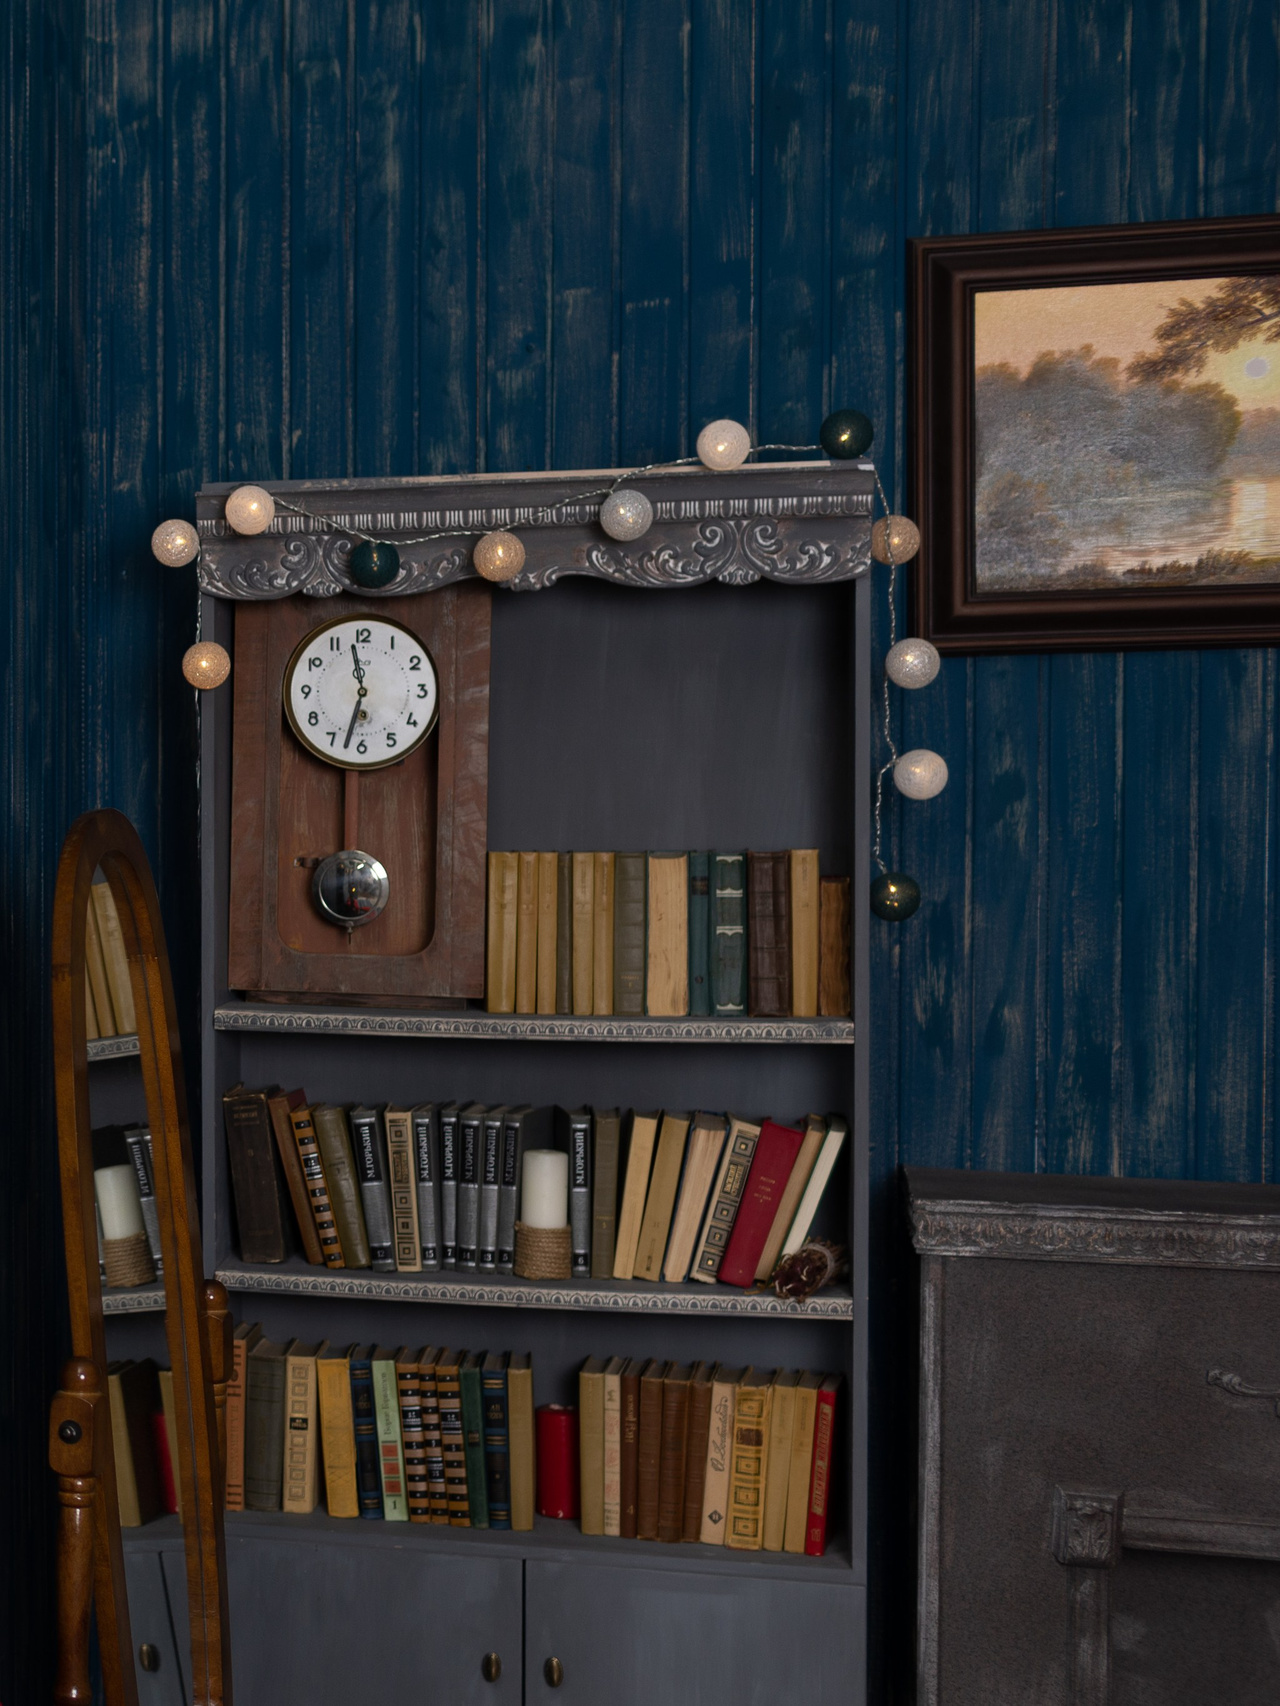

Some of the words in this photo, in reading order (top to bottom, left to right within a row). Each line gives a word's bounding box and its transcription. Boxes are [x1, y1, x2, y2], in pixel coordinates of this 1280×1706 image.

[355, 628, 371, 643] 12
[390, 635, 395, 650] 1
[329, 636, 341, 651] 11
[308, 656, 323, 672] 10
[409, 655, 422, 671] 2
[300, 684, 312, 699] 9
[417, 683, 428, 699] 3
[308, 711, 319, 726] 8
[406, 712, 418, 728] 4
[326, 731, 337, 747] 7
[356, 739, 368, 754] 6
[386, 732, 397, 748] 5
[360, 1125, 376, 1178] М.ГОРЬКИЙ
[417, 1125, 431, 1179] М.ГОРЬКИЙ
[443, 1125, 454, 1178] М.ГОРЬКИЙ
[486, 1128, 498, 1182] М.ГОРЬКИЙ
[376, 1249, 385, 1258] 12
[425, 1250, 434, 1258] 15
[447, 1248, 452, 1257] 7
[578, 1255, 584, 1264] 6
[392, 1500, 398, 1510] 1
[627, 1505, 634, 1516] 4
